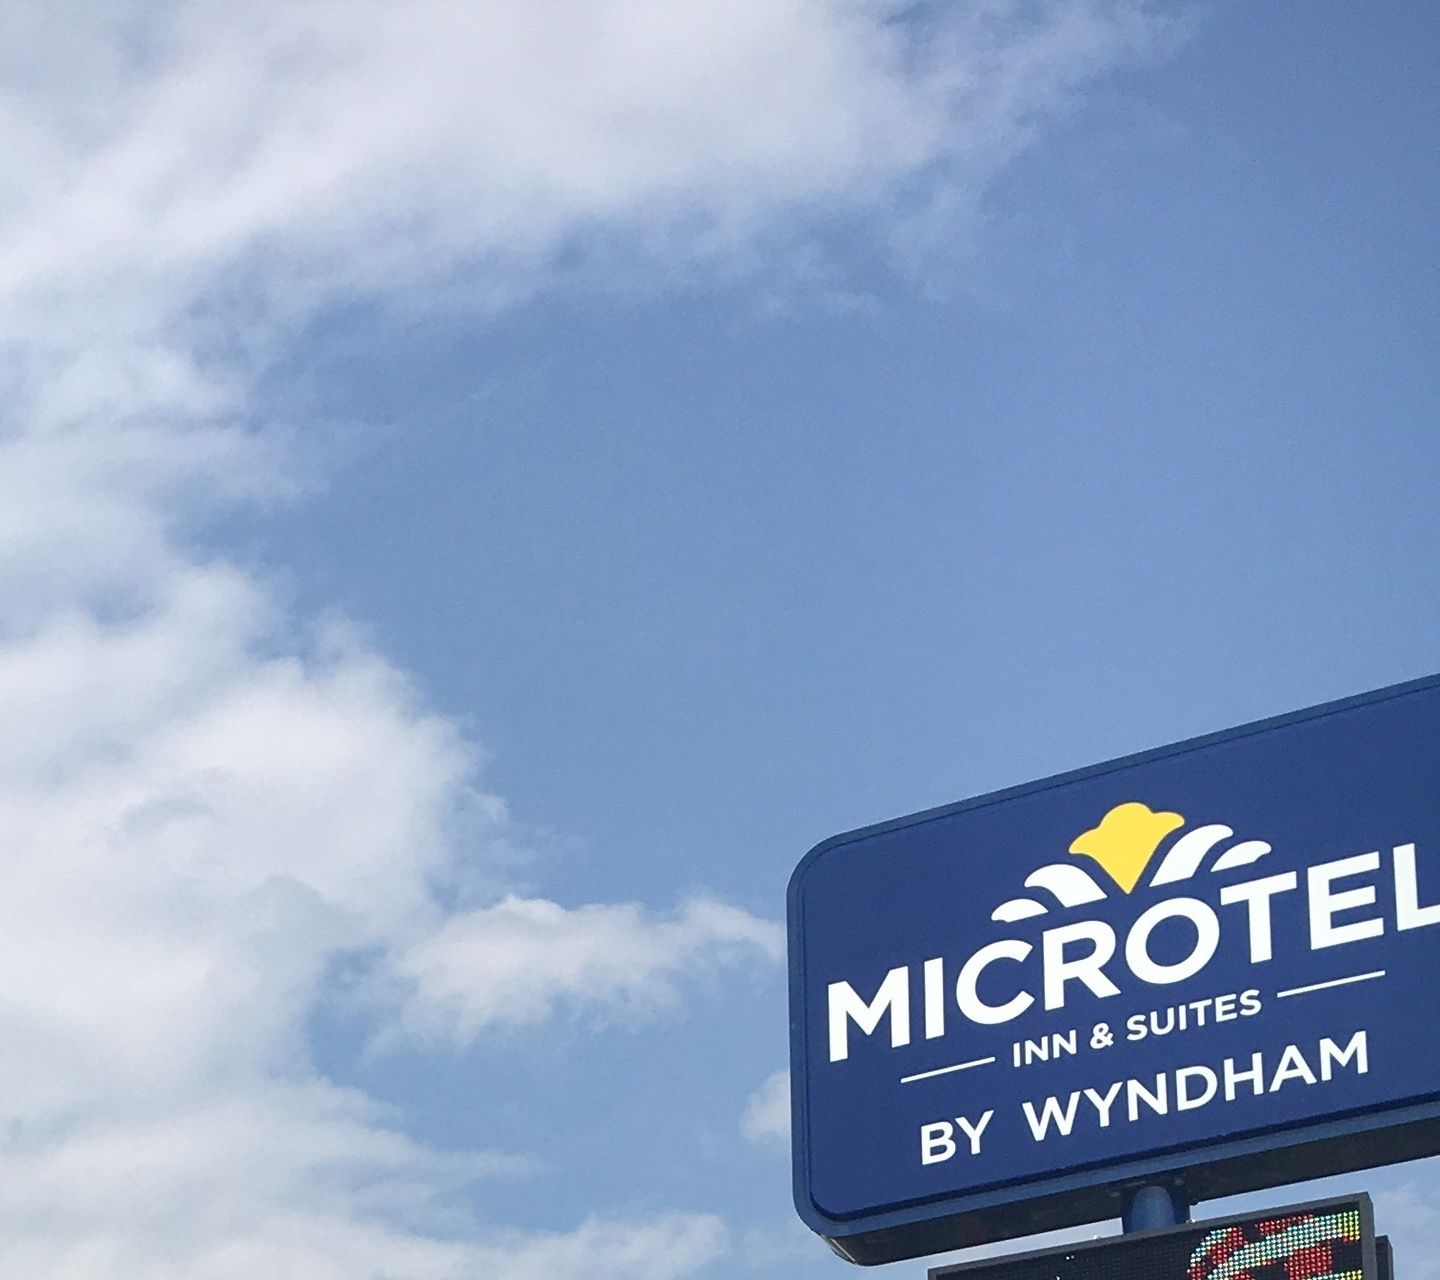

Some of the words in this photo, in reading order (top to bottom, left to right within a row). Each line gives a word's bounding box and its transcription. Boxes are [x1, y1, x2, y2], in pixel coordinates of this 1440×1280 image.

[827, 843, 1440, 1062] MICROTEL
[1013, 1030, 1078, 1067] INN
[1089, 1022, 1114, 1049] &
[1126, 989, 1262, 1041] SUITES
[920, 1111, 994, 1166] BY
[1022, 1031, 1368, 1142] WYNDHAM
